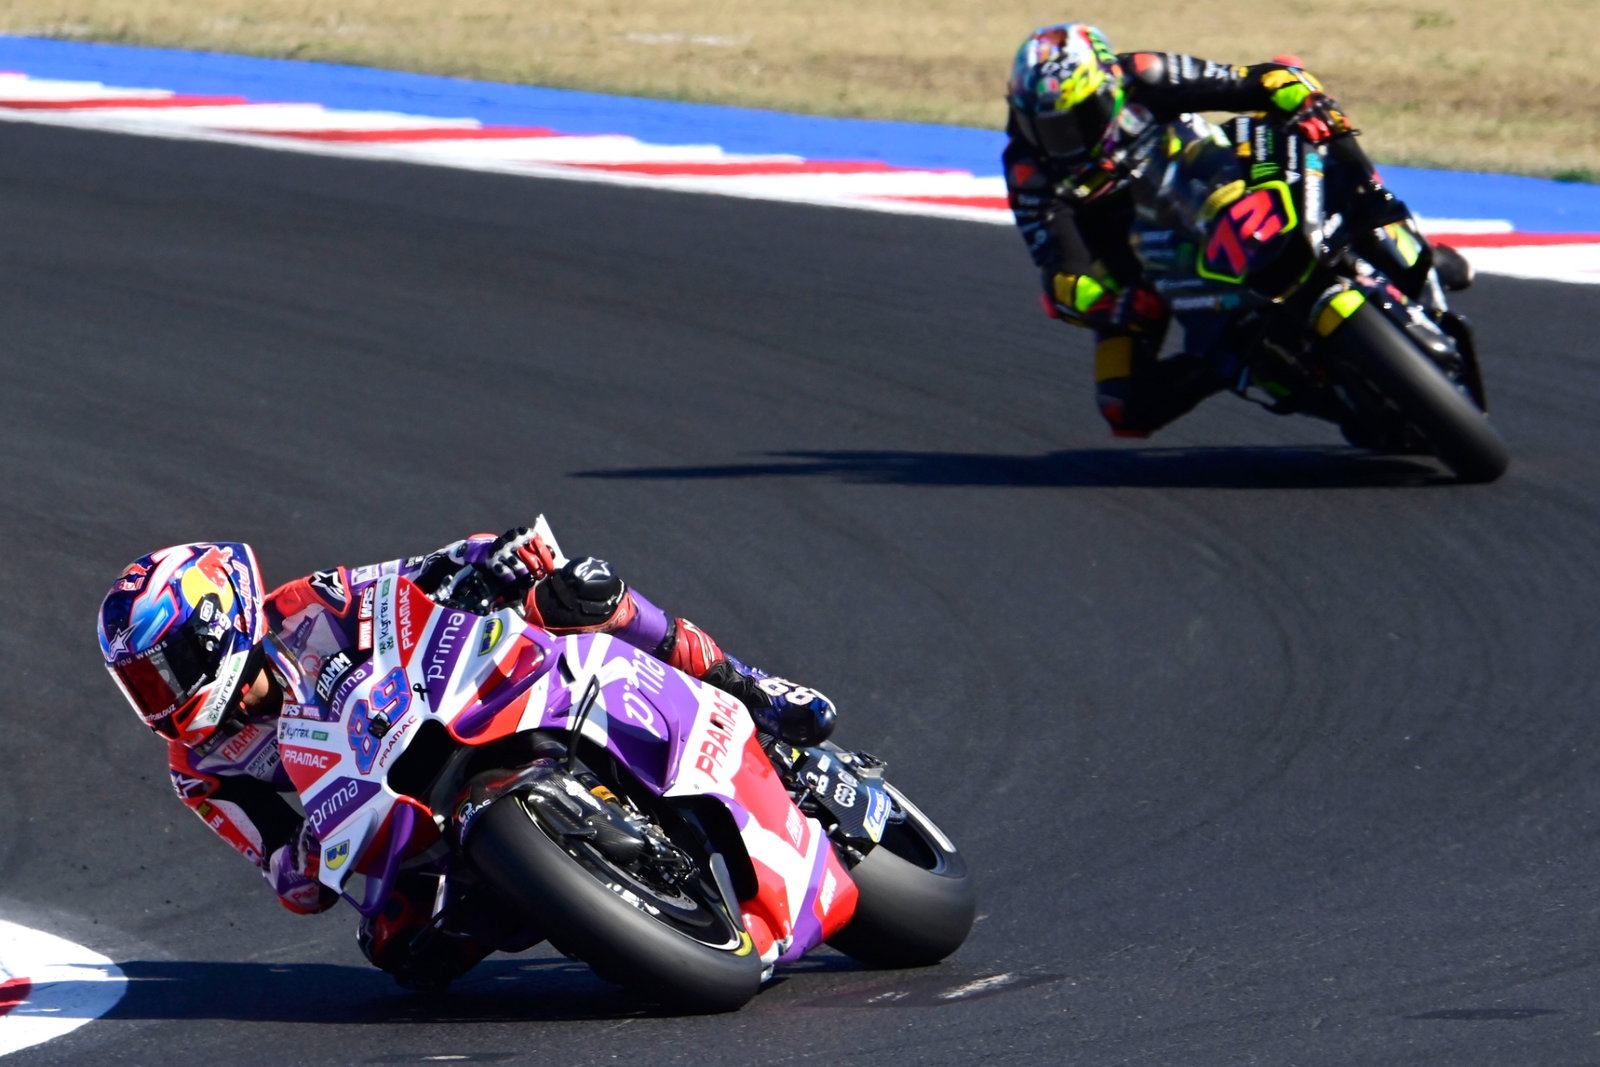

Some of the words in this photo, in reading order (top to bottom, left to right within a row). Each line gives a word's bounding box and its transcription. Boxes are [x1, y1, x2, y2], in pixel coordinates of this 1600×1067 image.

[401, 584, 414, 650] PRAMAC
[136, 641, 168, 660] WINGS
[427, 612, 466, 682] prima
[316, 651, 353, 700] FIAMM
[331, 667, 367, 717] prima
[222, 723, 260, 761] FIAMM
[347, 666, 413, 776] 89
[379, 715, 419, 768] PRAMAC
[695, 690, 740, 784] PRAMAC
[283, 749, 329, 769] PRAMAC
[309, 779, 360, 834] prima
